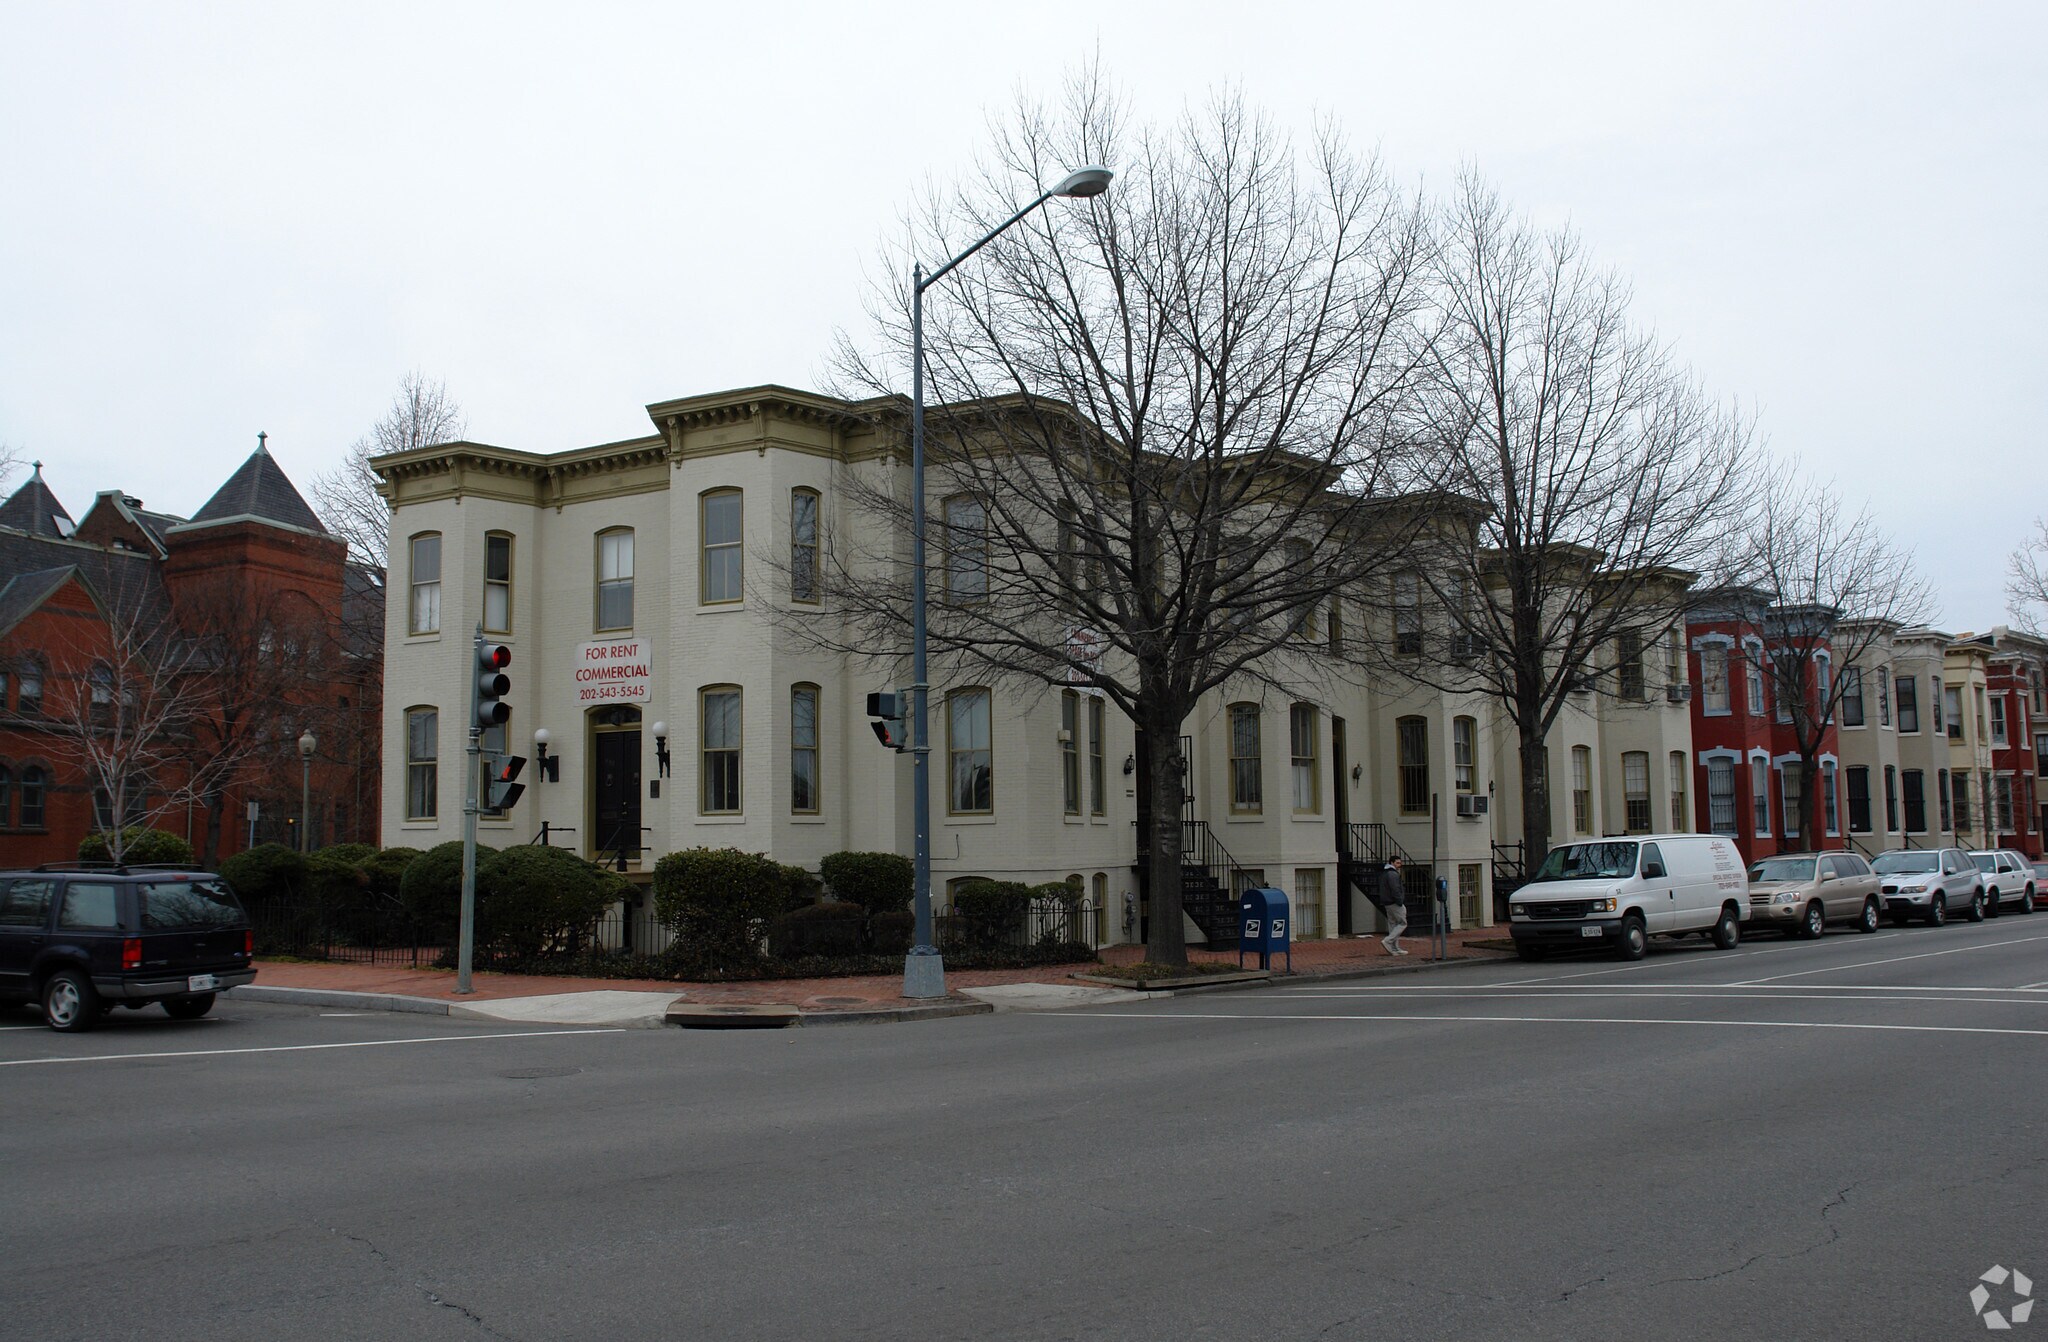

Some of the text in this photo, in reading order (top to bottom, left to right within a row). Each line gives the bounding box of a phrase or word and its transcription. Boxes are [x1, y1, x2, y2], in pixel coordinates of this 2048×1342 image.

[586, 644, 638, 660] FOR RENT
[576, 665, 649, 682] COMMERCIAL
[580, 686, 644, 700] 202-543-5545
